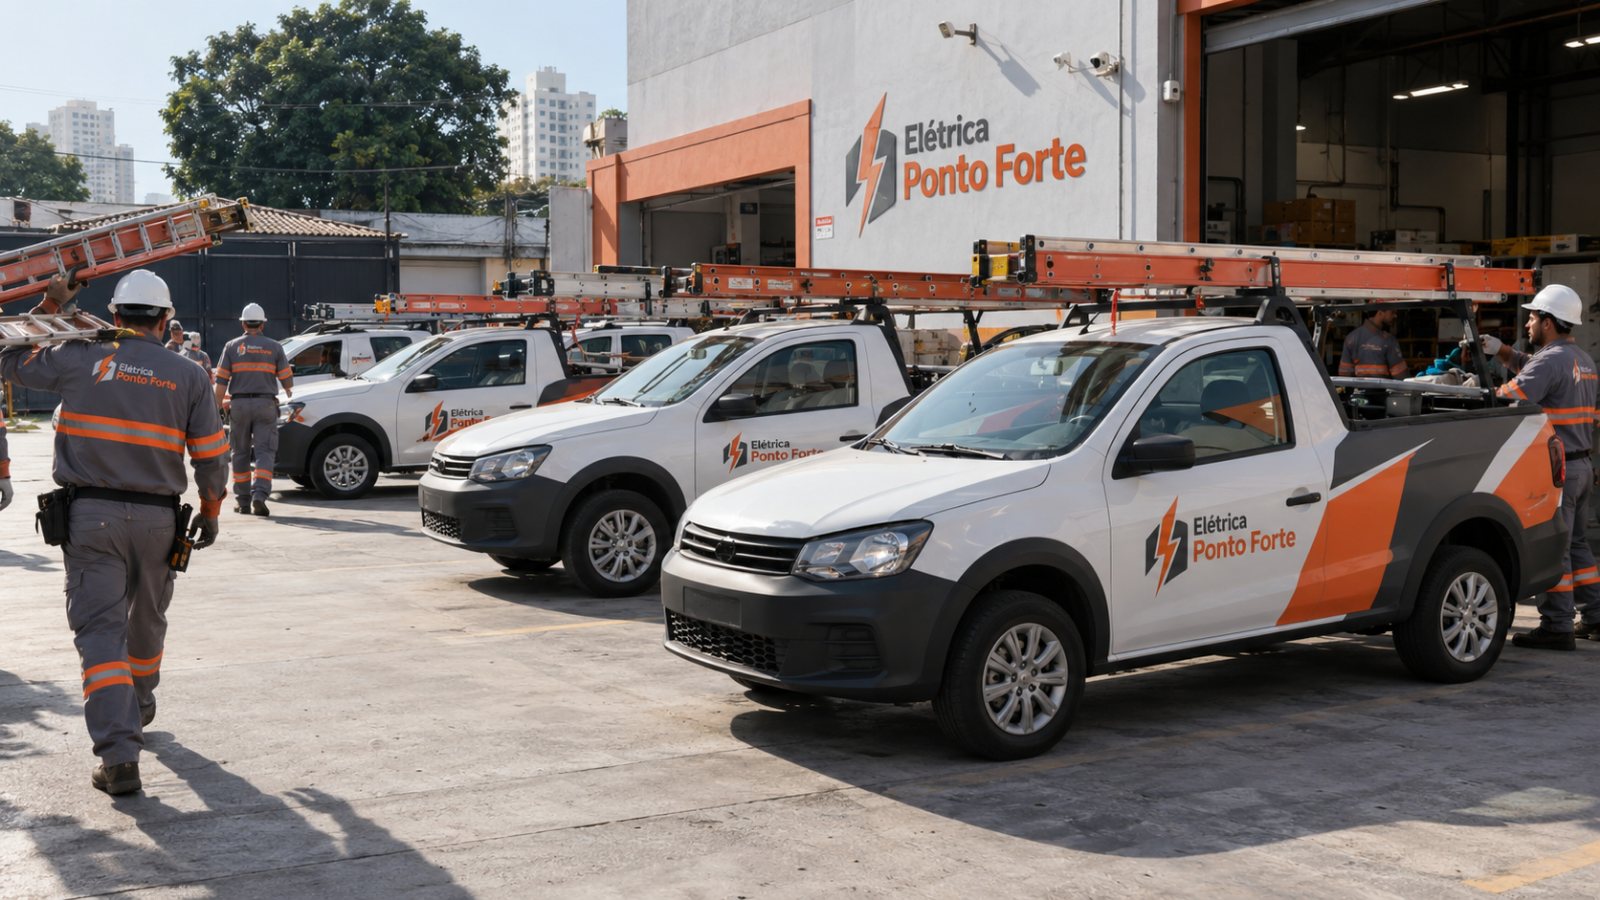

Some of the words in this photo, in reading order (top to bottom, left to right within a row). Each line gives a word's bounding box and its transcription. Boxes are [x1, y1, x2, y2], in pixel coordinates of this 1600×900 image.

[905, 114, 989, 155] Elétrica
[904, 154, 988, 200] Ponto
[996, 137, 1087, 188] Forte
[119, 363, 153, 376] Elétrica
[116, 371, 147, 384] Ponto
[150, 376, 176, 390] Forte
[451, 408, 483, 417] Elétrica
[751, 439, 790, 449] Elétrica
[751, 450, 788, 462] Ponto
[1194, 513, 1247, 536] Elétrica
[1193, 535, 1246, 562] Ponto
[1251, 528, 1296, 553] Forte
